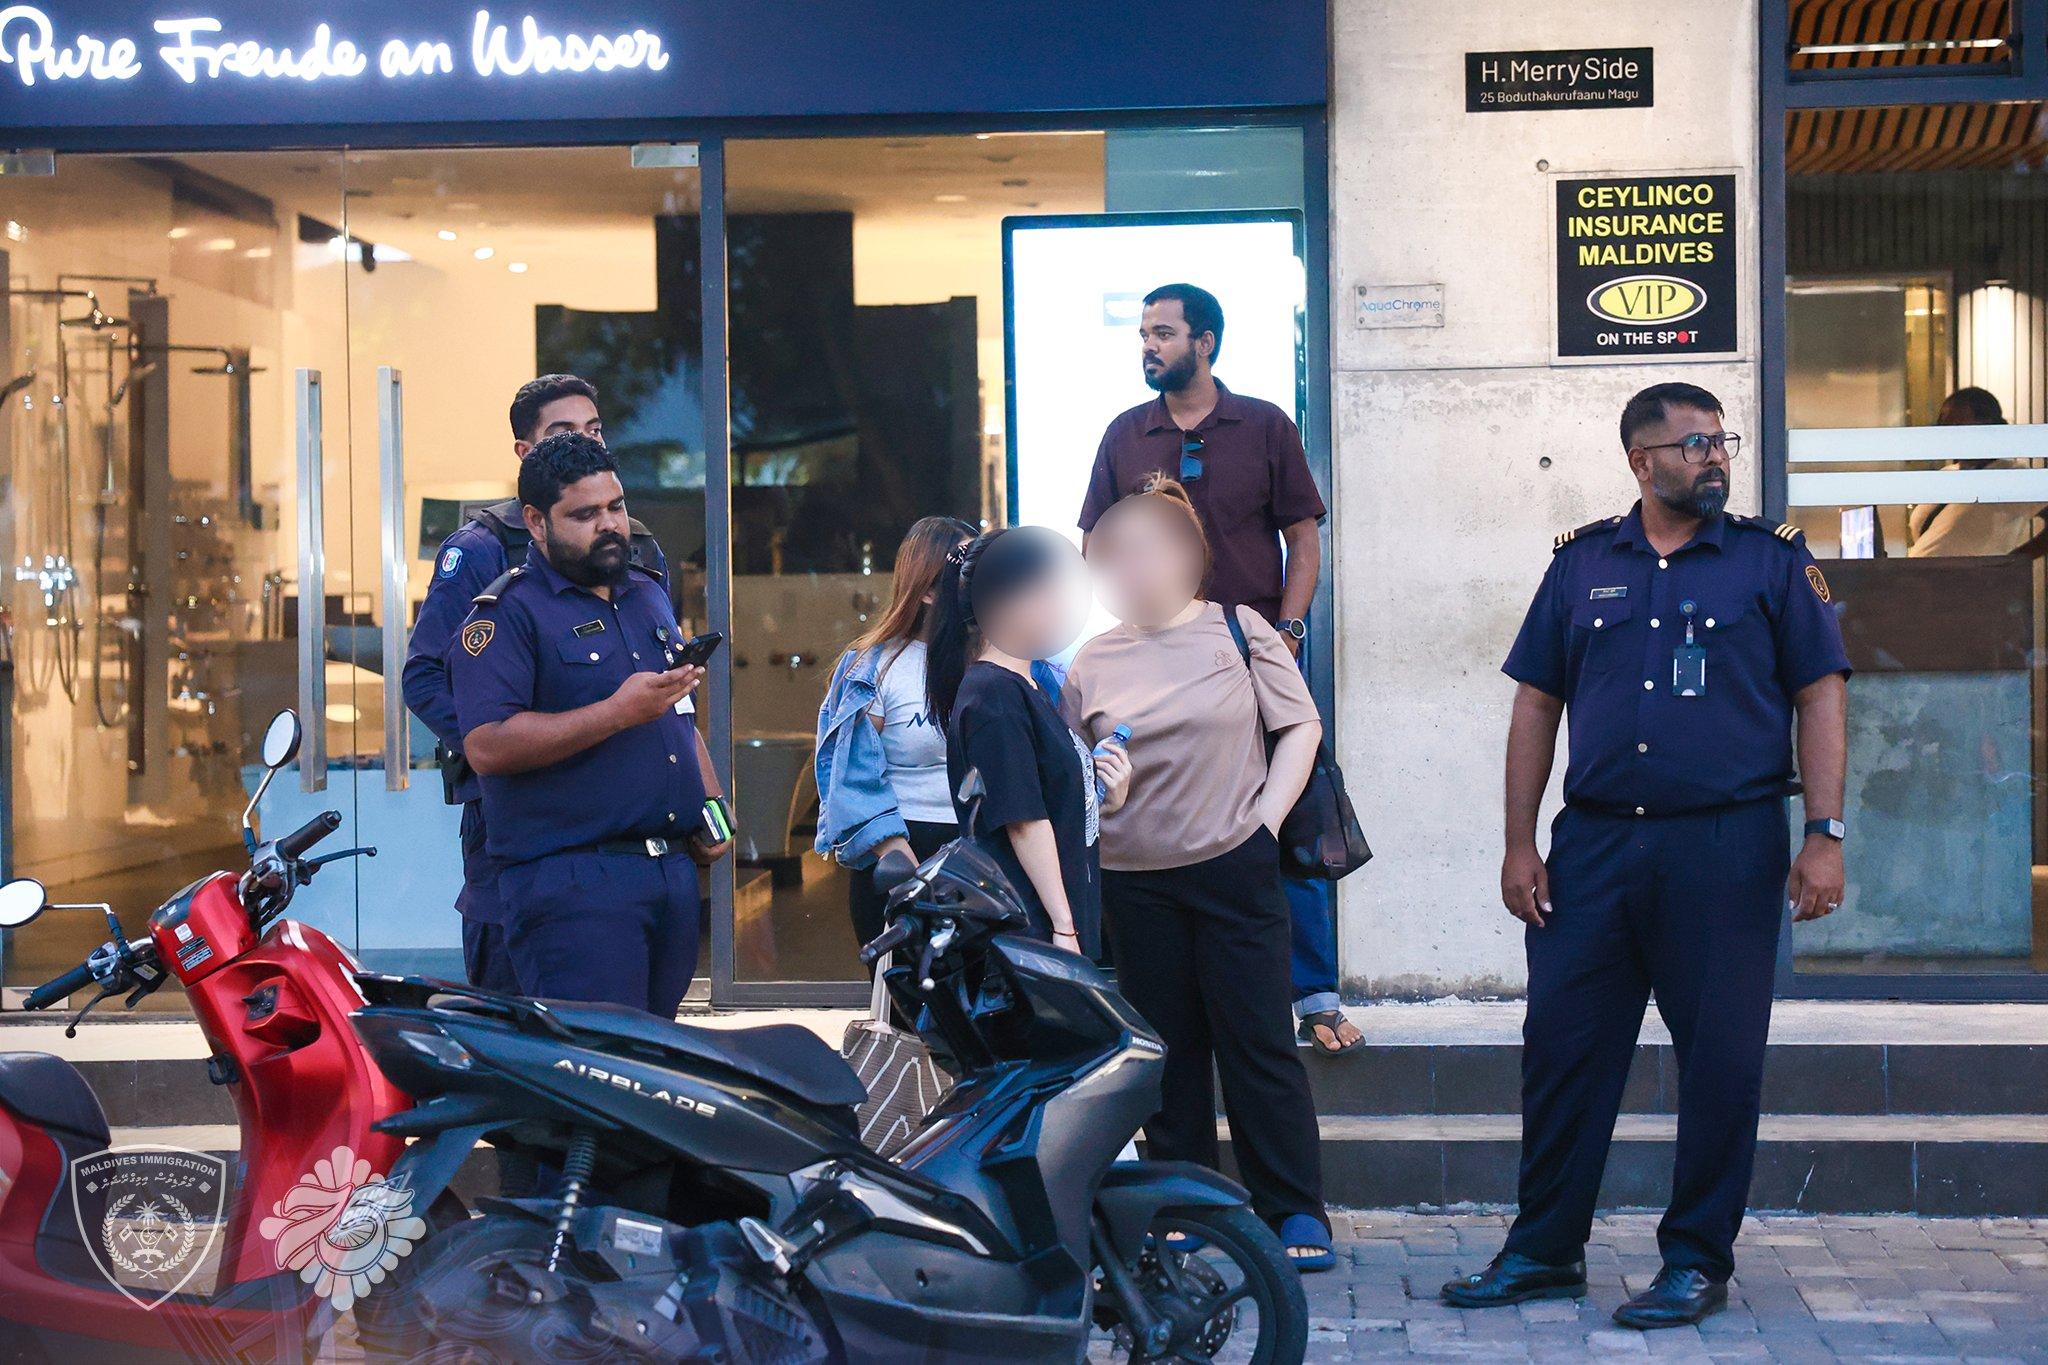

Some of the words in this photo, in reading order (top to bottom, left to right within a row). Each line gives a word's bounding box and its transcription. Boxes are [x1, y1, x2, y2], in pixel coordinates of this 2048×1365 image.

[0, 5, 143, 87] Pure
[153, 17, 367, 84] Freude
[379, 39, 454, 79] an
[471, 9, 670, 77] Wasser
[1481, 60, 1507, 83] H.
[1510, 60, 1581, 87] Merry
[1584, 57, 1639, 81] Side
[1480, 92, 1495, 103] 25
[1497, 89, 1605, 103] Boduthakurufaanu
[1607, 88, 1640, 101] Magu
[1577, 183, 1714, 209] CEYLINCO
[1567, 212, 1725, 238] INSURANCE
[1578, 241, 1715, 267] MALDIVES
[1617, 284, 1677, 316] VIP
[1596, 332, 1620, 346] ON
[1622, 331, 1654, 346] THE
[1656, 329, 1699, 344] SPOT
[1131, 1036, 1163, 1052] HONDA
[552, 1058, 718, 1119] AIRBLADE
